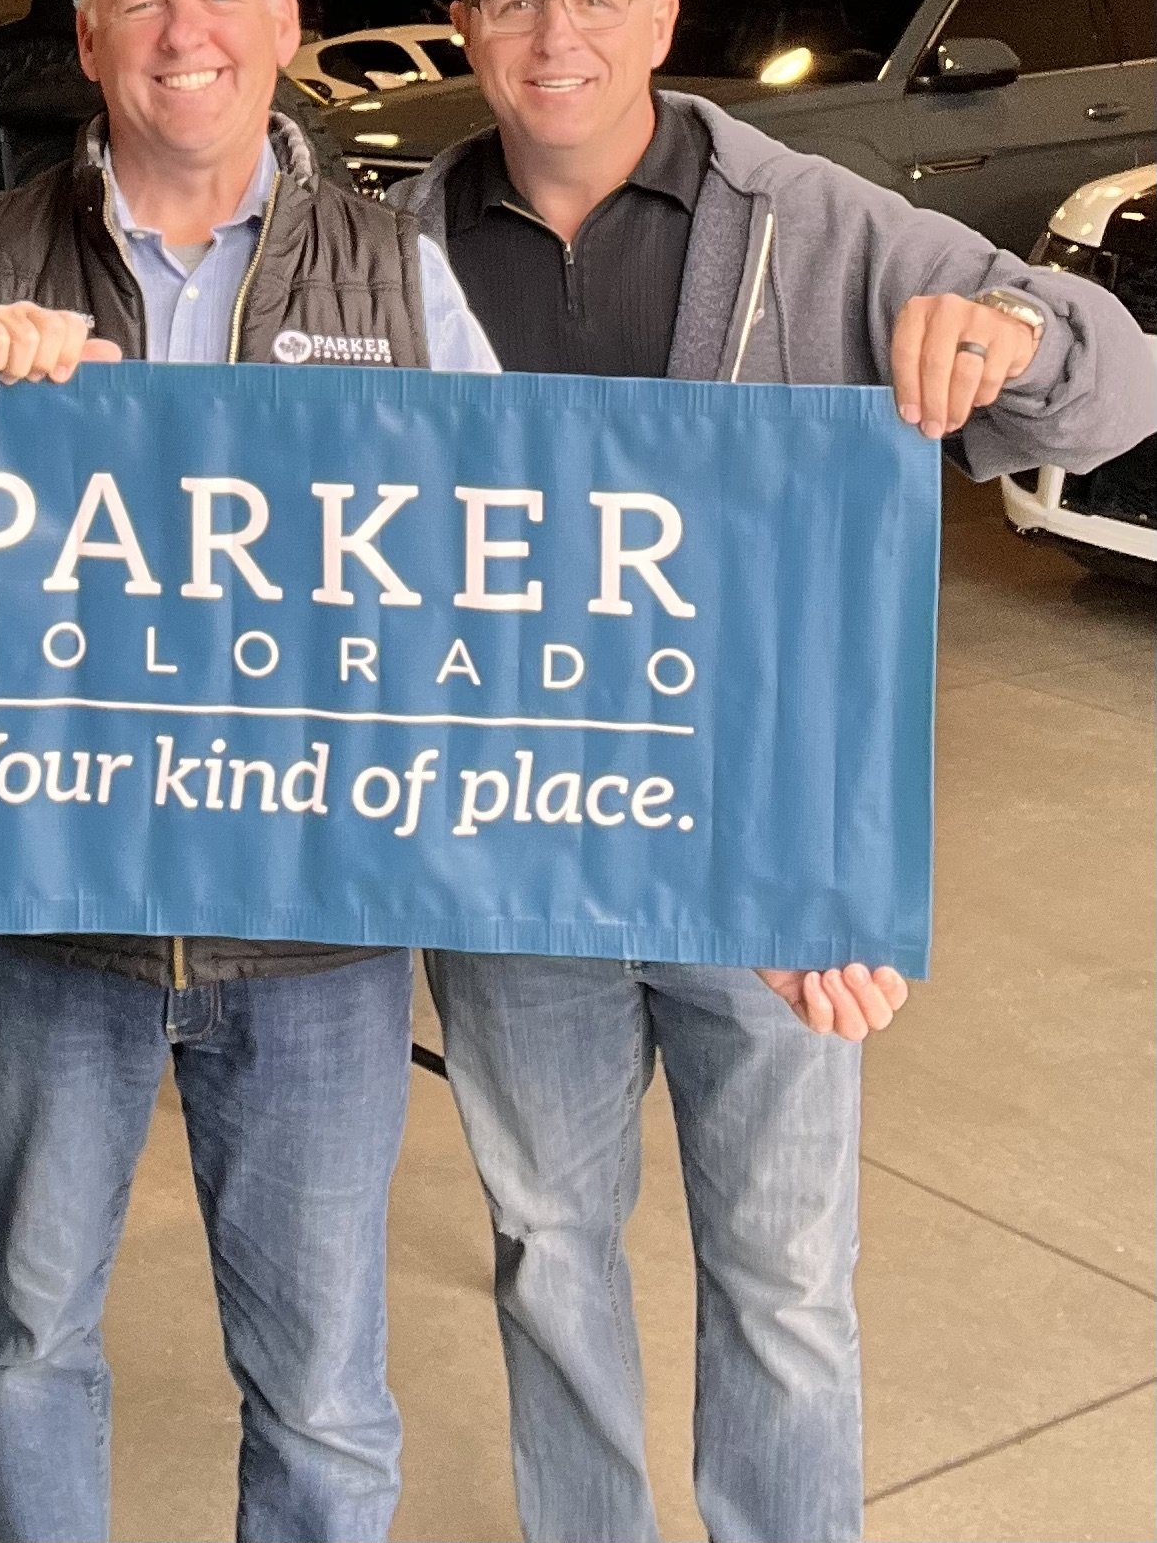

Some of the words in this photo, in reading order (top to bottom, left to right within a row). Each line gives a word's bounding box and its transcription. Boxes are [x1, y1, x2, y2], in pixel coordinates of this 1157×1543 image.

[312, 334, 391, 354] PARKER
[313, 350, 392, 364] COLORADO
[154, 735, 330, 815] kind
[351, 748, 441, 838] of
[451, 749, 695, 838] place.
